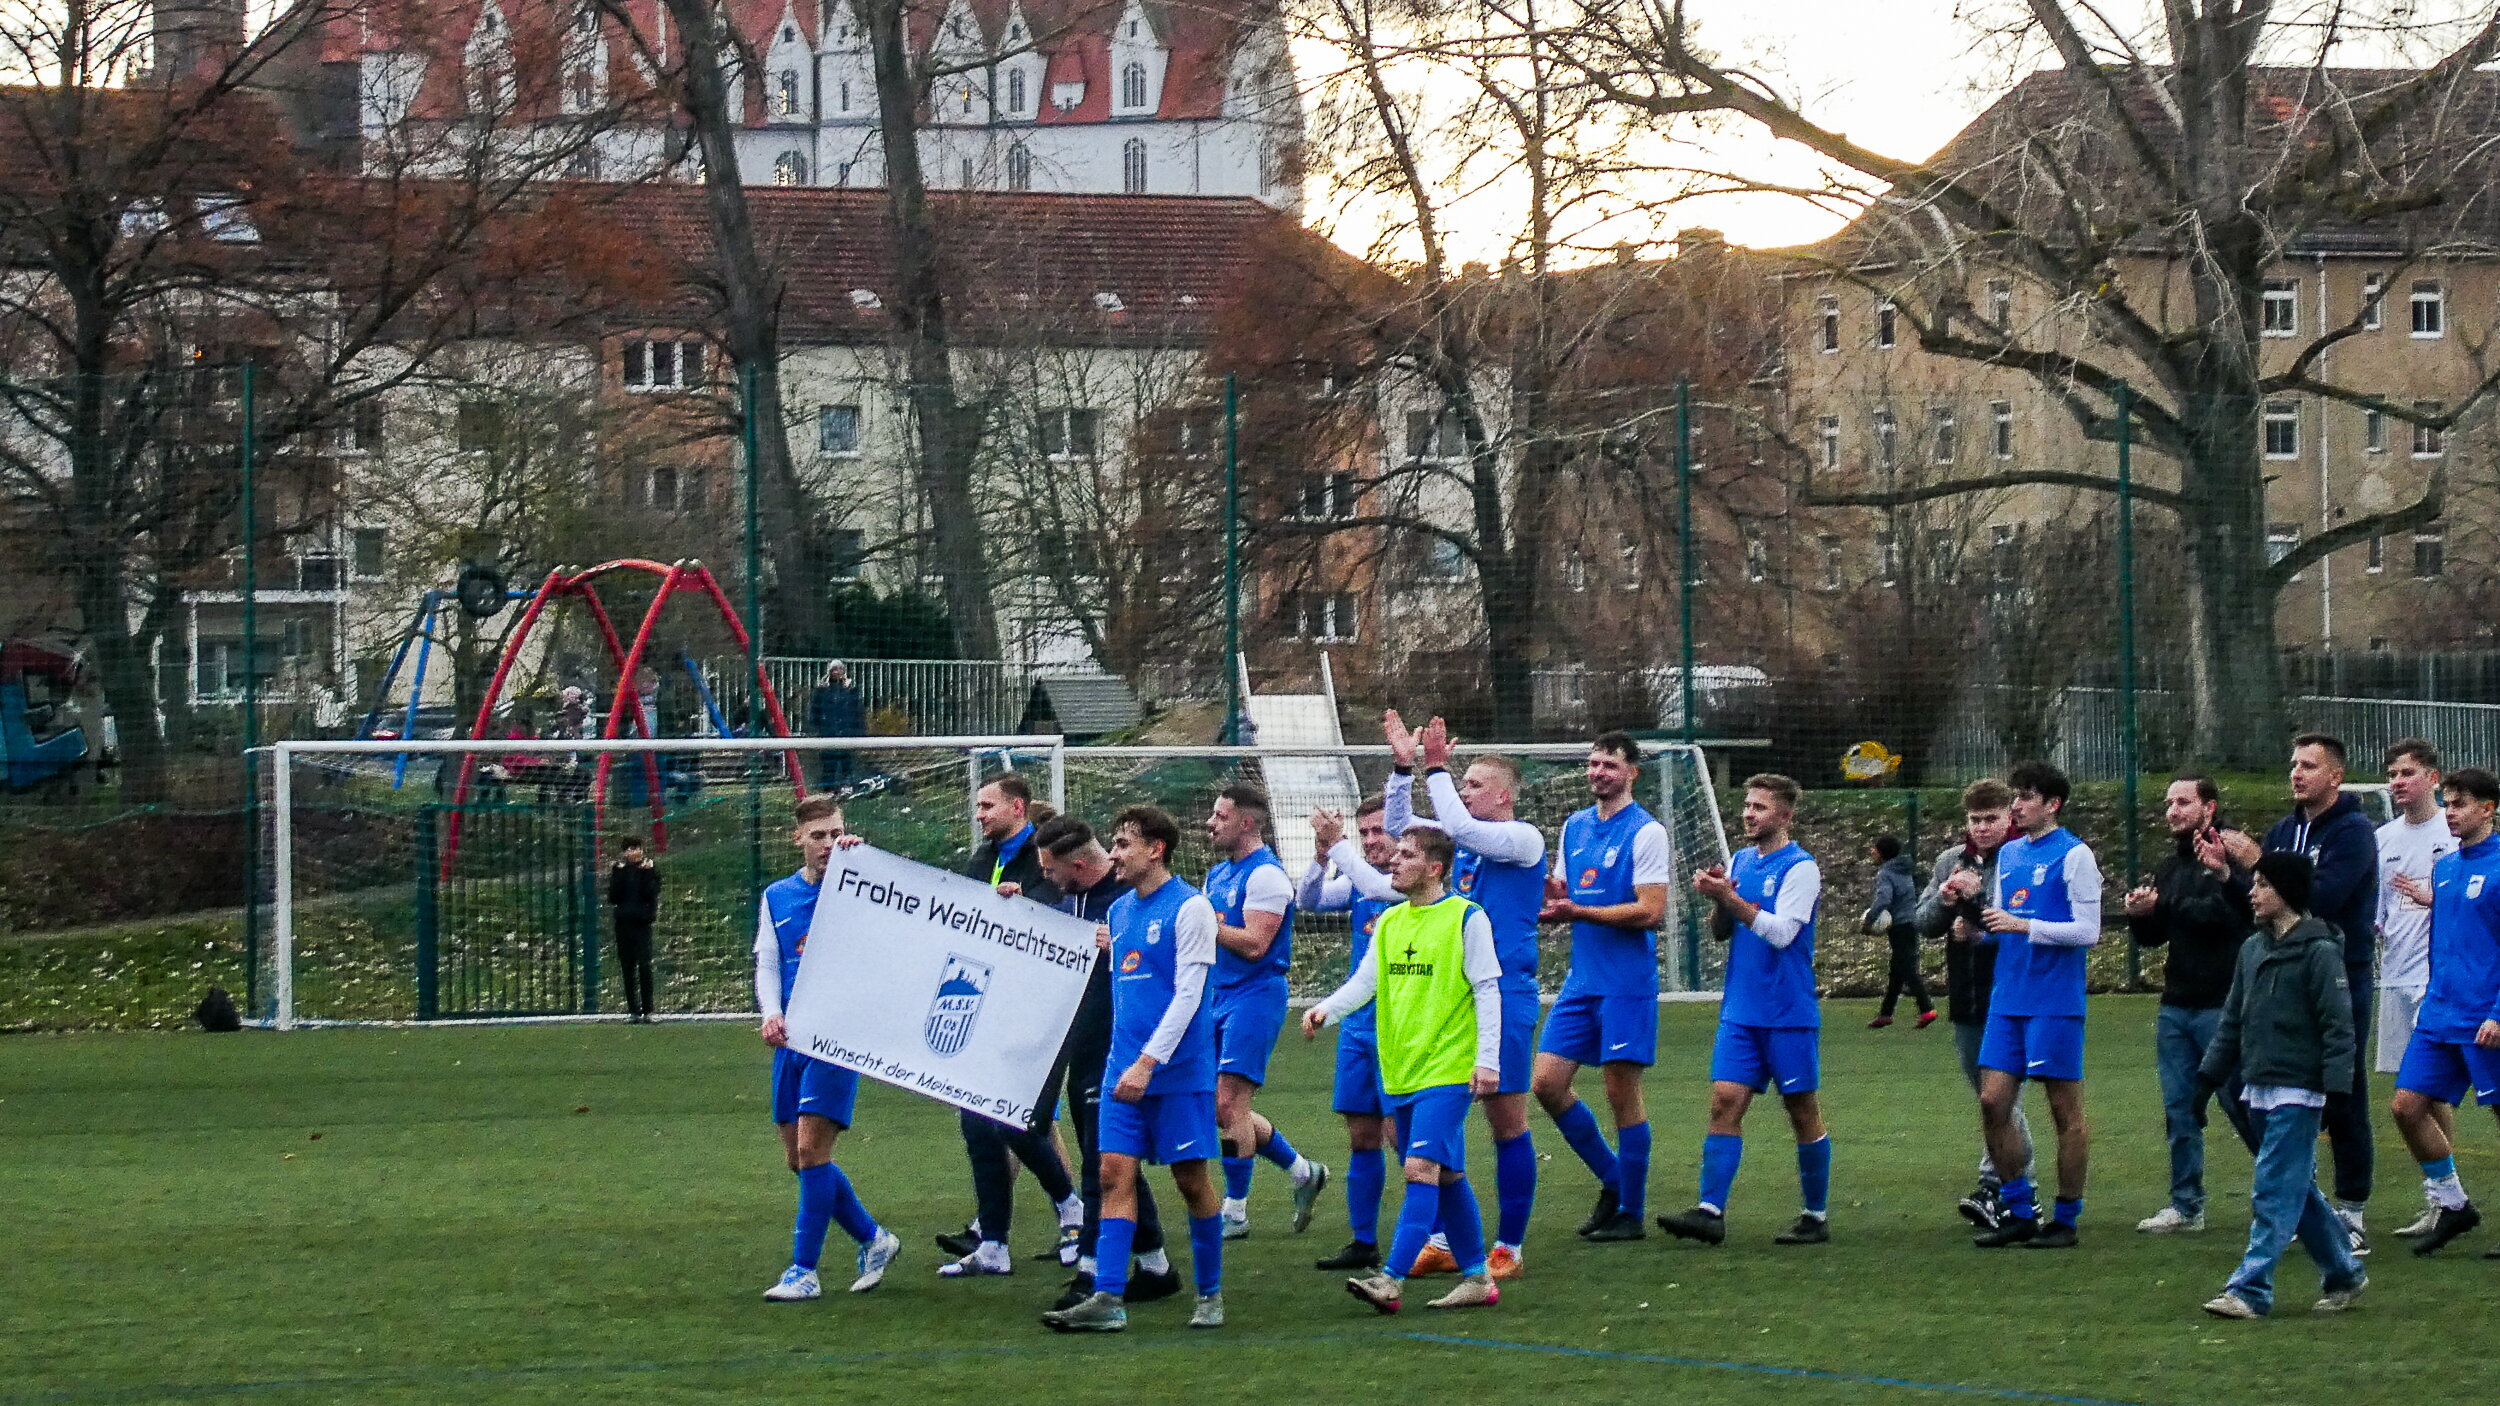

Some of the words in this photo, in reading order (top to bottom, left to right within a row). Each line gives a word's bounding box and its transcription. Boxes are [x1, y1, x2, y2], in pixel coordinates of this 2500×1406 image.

[838, 867, 921, 915] Frohe
[928, 895, 1092, 974] Weihnachtszeit
[812, 1034, 884, 1071] Wünscht
[885, 1062, 916, 1081] der
[917, 1072, 992, 1107] Meissner
[992, 1099, 1021, 1118] SV
